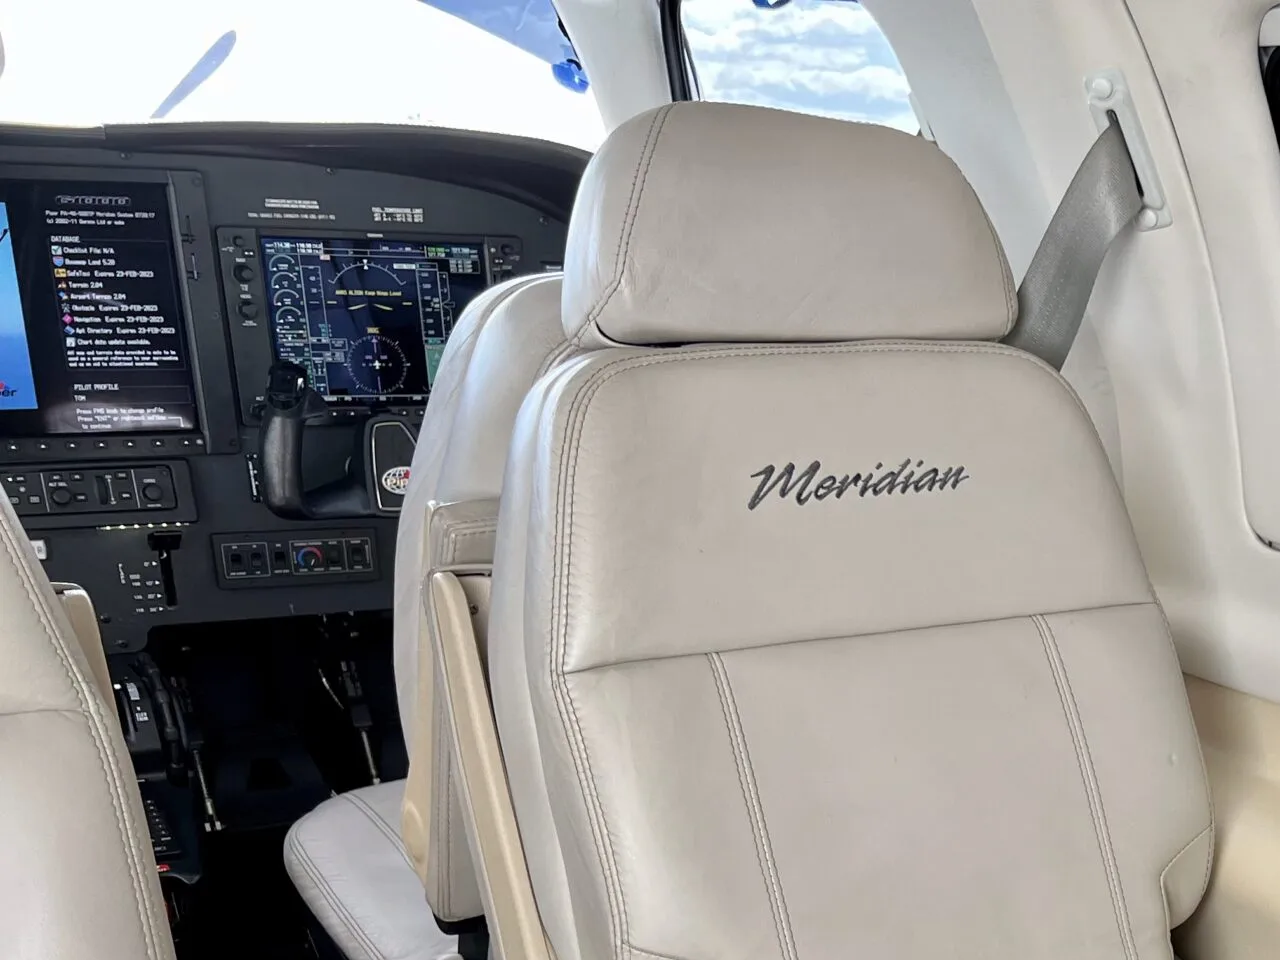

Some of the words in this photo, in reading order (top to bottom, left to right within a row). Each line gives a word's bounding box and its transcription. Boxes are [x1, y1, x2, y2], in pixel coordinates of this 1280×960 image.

[50, 235, 80, 243] DATABASE
[74, 383, 92, 391] PILOT
[93, 383, 120, 391] PROFILE
[748, 458, 970, 511] Meridian
